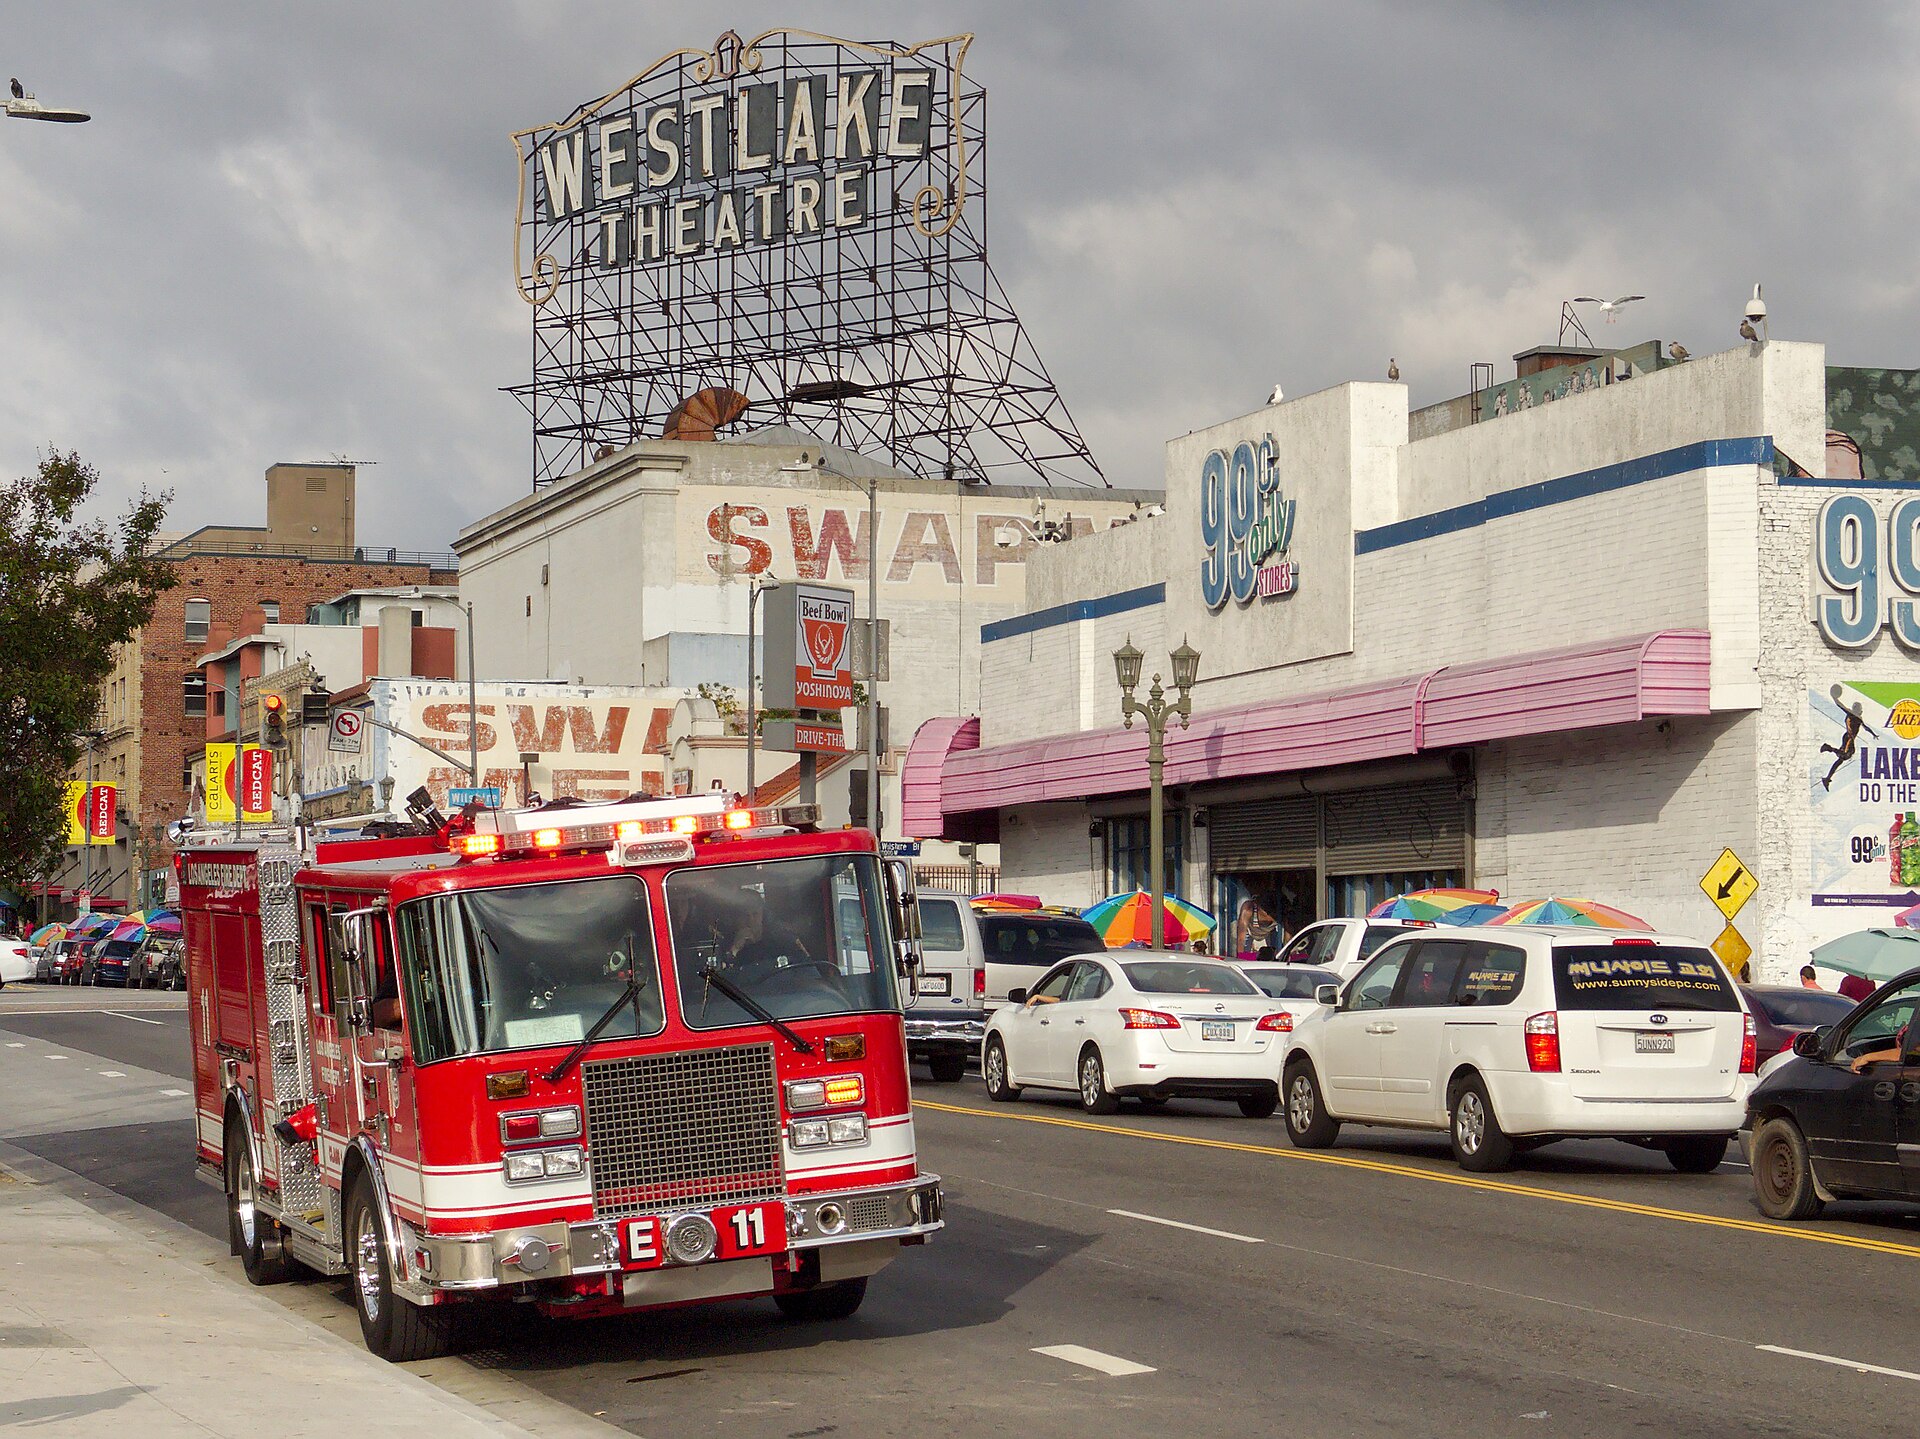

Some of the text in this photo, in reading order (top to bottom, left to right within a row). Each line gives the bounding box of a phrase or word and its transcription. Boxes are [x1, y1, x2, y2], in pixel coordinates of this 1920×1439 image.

[541, 70, 931, 219] WESTLAKE
[600, 168, 867, 267] THEATRE
[1248, 490, 1296, 568] only
[706, 504, 1034, 585] SWAP
[1258, 562, 1292, 597] STORES
[802, 600, 847, 622] Beef Bowl
[796, 682, 852, 700] YOSHINOYA
[1882, 708, 1920, 729] LAKE
[797, 730, 846, 748] DRIVE-THR
[252, 751, 262, 811] REDCAT
[1860, 783, 1917, 803] DO THE
[99, 787, 109, 836] REDCAT
[881, 842, 907, 851] Wilshire
[1871, 845, 1886, 859] only
[188, 863, 198, 886] LOS
[197, 863, 221, 887] ANGELES
[1573, 977, 1721, 992] www.sunnysidepc.com
[1652, 1016, 1667, 1024] KIA
[1637, 1039, 1673, 1050] 5UNN920
[629, 1208, 765, 1259] E 11
